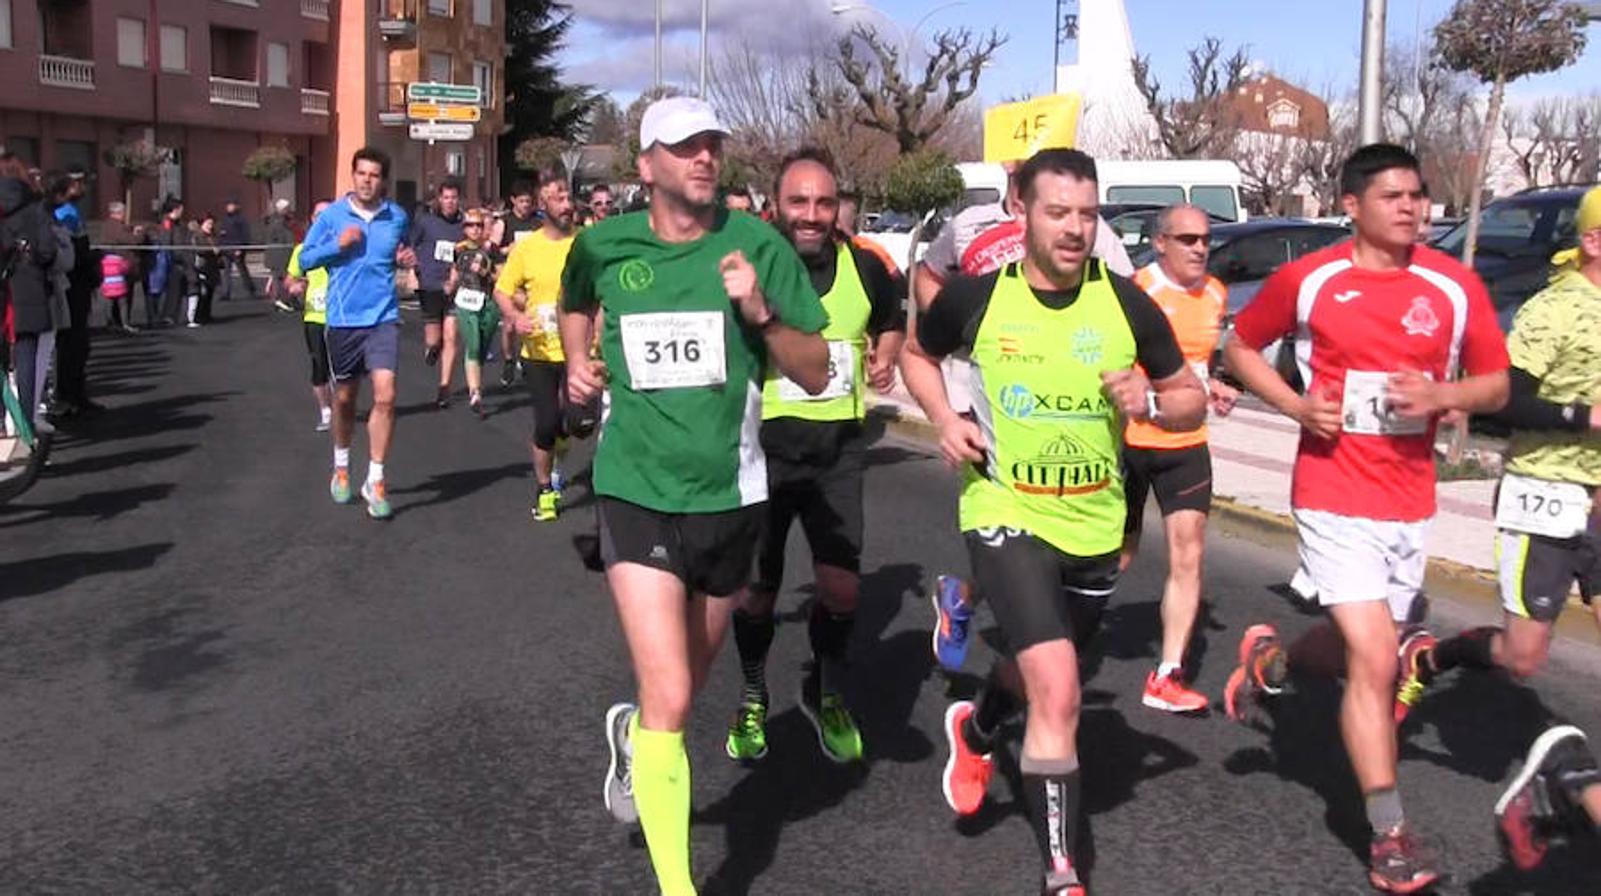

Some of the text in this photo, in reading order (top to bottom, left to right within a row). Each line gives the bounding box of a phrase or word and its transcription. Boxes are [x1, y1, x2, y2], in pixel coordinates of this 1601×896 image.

[1012, 113, 1049, 144] 45
[644, 339, 701, 365] 316
[1517, 492, 1564, 518] 170
